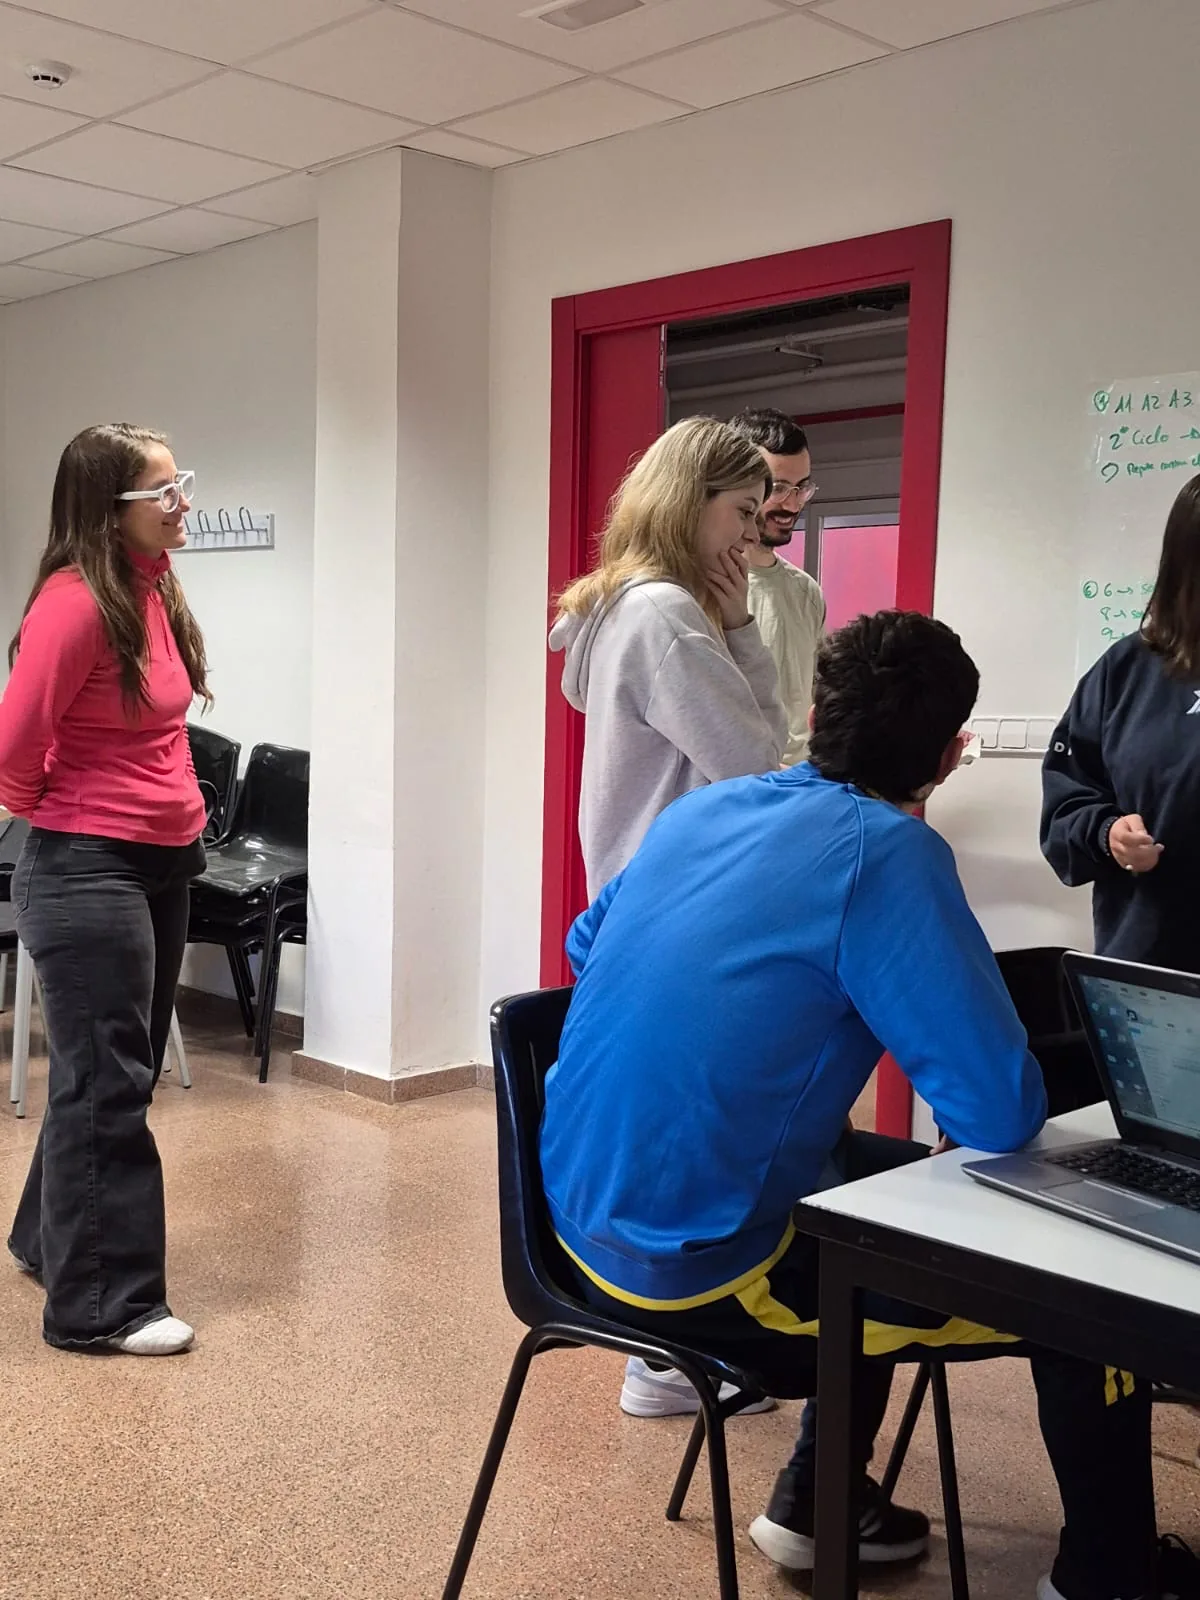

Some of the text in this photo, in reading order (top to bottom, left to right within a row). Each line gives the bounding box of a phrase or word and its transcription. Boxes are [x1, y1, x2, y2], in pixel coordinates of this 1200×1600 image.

[1142, 394, 1160, 411] A2
[1169, 389, 1194, 408] A3
[1132, 424, 1169, 445] Ciclo
[1103, 582, 1113, 597] 6
